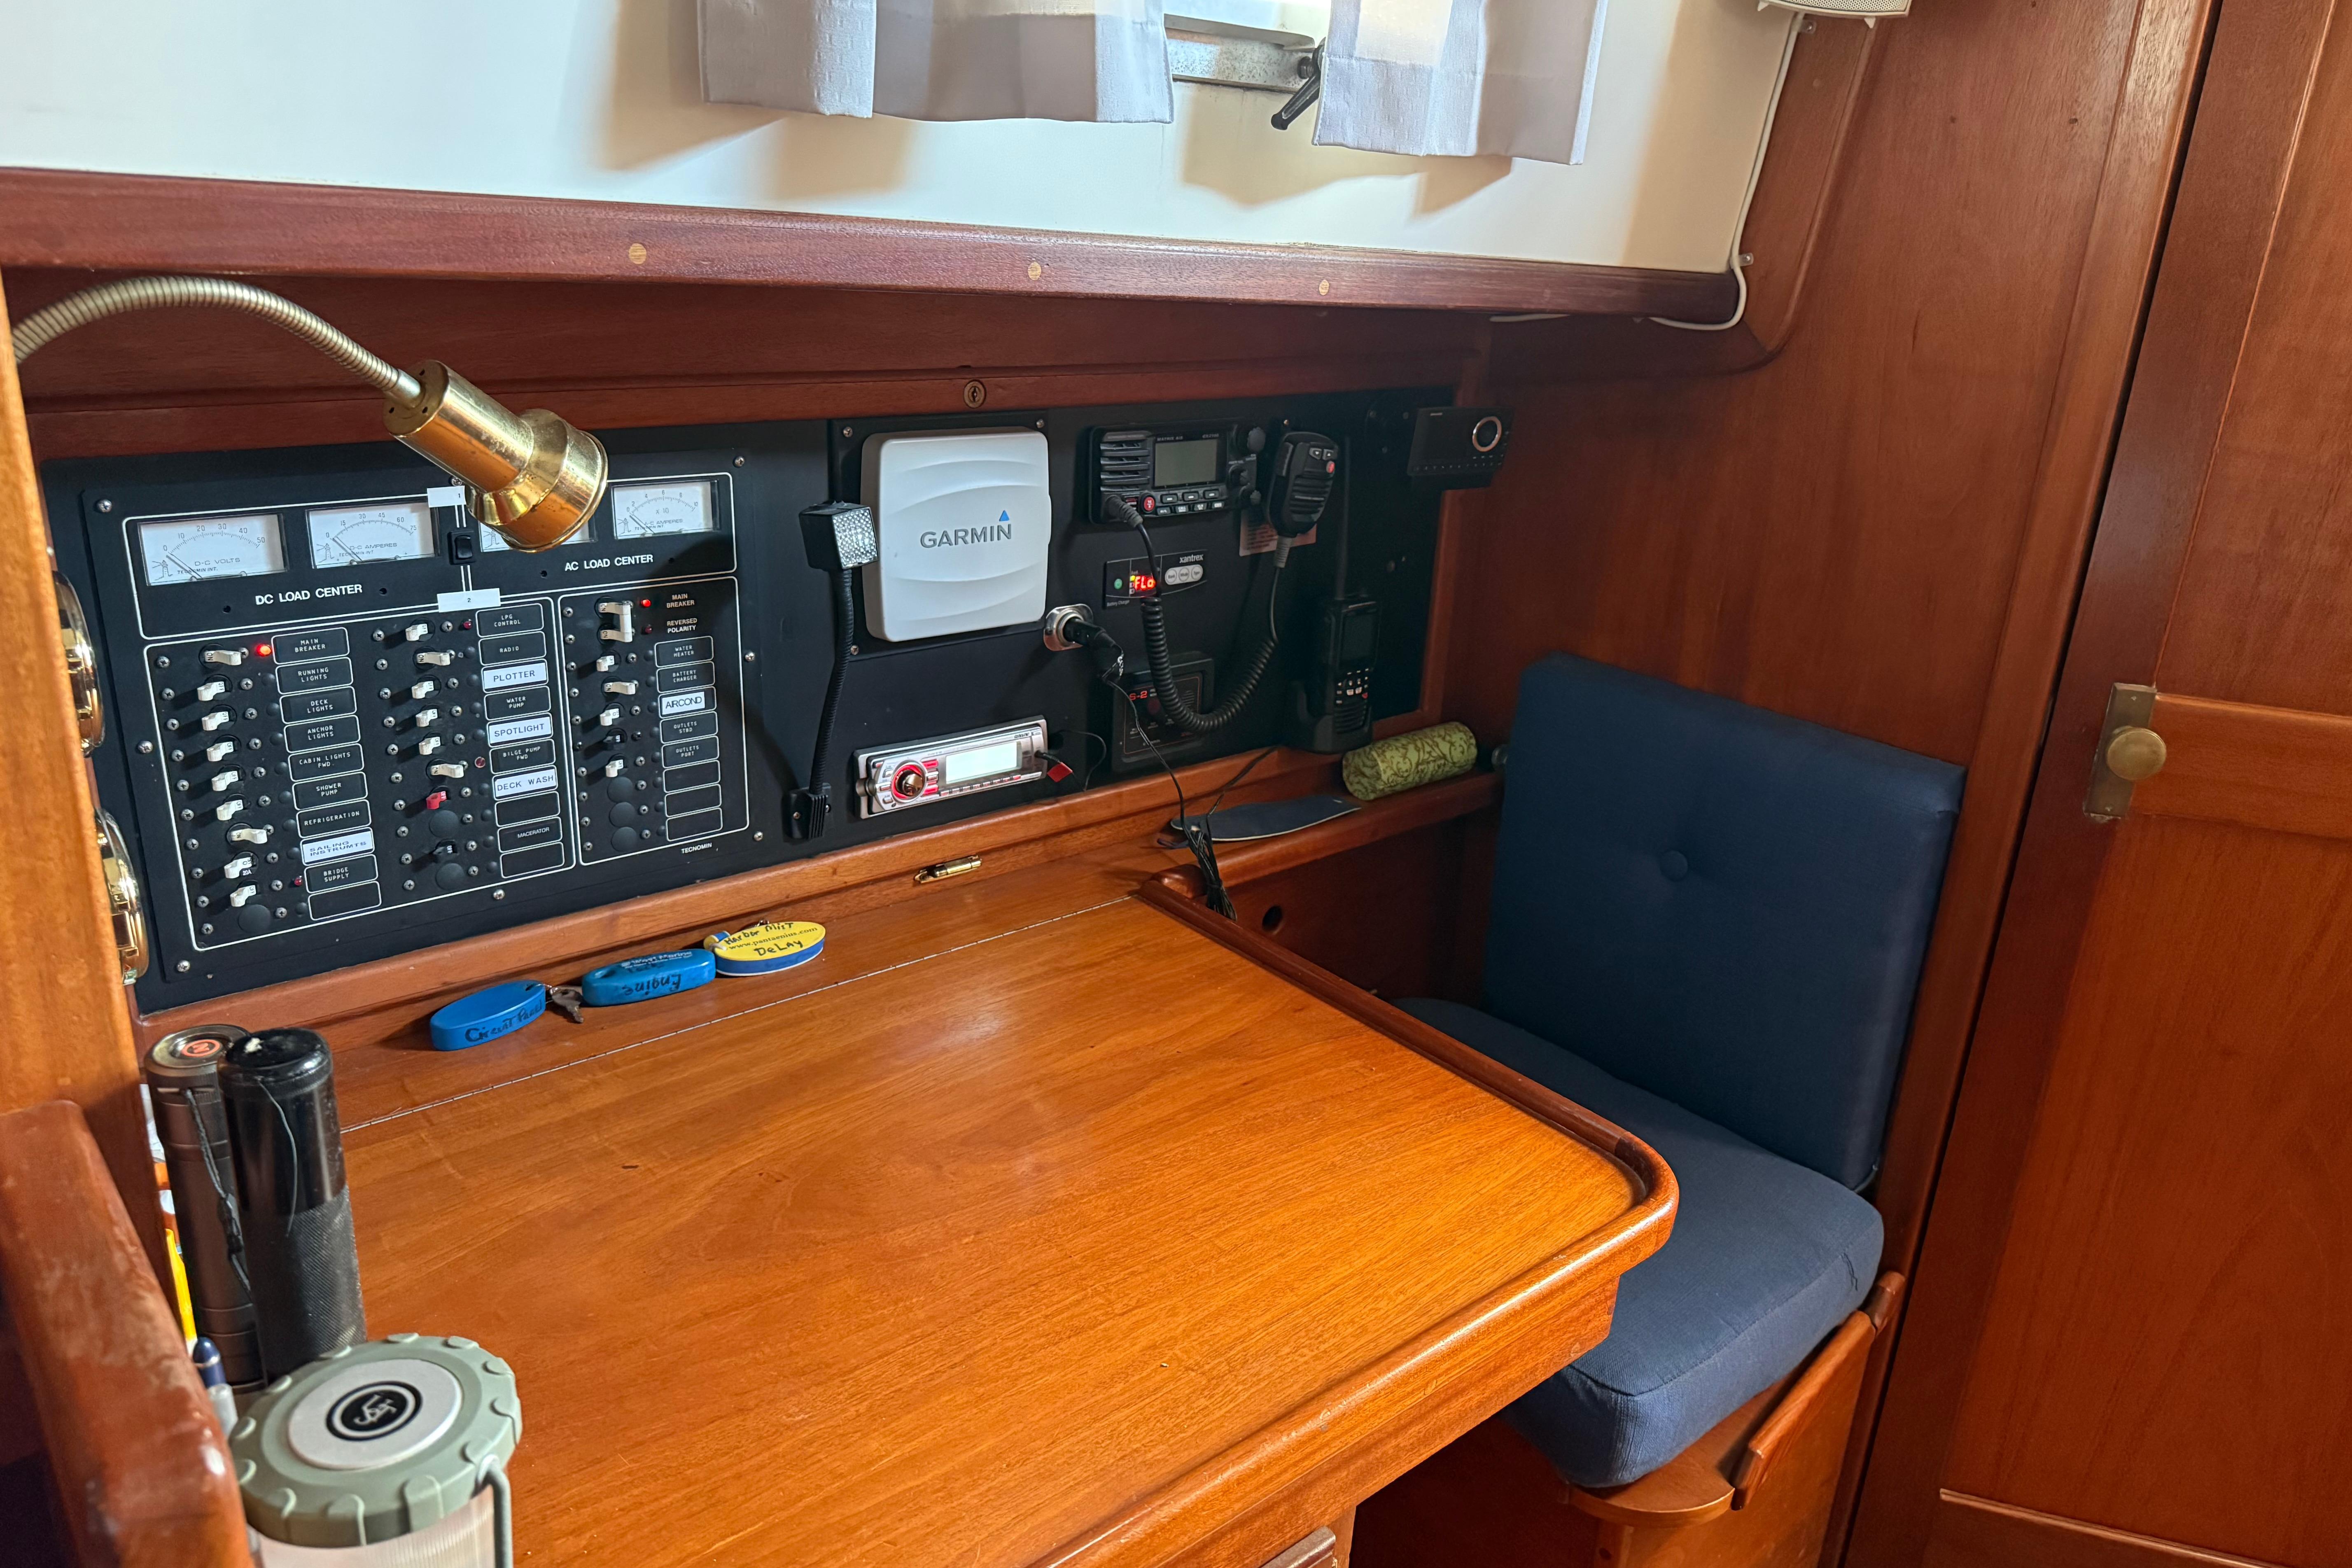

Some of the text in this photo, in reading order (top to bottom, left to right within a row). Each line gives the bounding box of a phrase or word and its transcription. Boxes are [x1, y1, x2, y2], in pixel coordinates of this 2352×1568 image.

[920, 524, 1011, 548] GARMIN
[565, 554, 654, 572] AC LOAD CENTER
[1179, 554, 1204, 564] xantrex
[255, 584, 362, 605] DC LOAD CENTER
[666, 600, 695, 609] BREAKER
[667, 618, 698, 627] REVERSED
[667, 625, 697, 634] POLARITY
[294, 644, 326, 653] BREAKER
[298, 667, 329, 677] RUNNING
[493, 670, 536, 682] PLOTTER
[301, 674, 327, 683] LIGHTS
[665, 696, 702, 709] AIRCOND
[307, 705, 334, 714] LIGHTS
[307, 725, 334, 734] ANCHOR
[494, 723, 545, 737] SPOTLIGHT
[673, 721, 697, 729] OUTLETS
[308, 732, 334, 740] LIGHTS
[503, 749, 522, 758] BILGE
[675, 745, 700, 754] OUTLETS
[299, 752, 351, 765] CABIN LIGHTS
[316, 782, 342, 792] SHOWER
[497, 775, 554, 791] DECK WASH
[304, 810, 360, 826] REFRIGERATION
[517, 827, 550, 838] MACERATOR
[310, 841, 349, 852] SAILING
[310, 841, 367, 857] INSTRUMTS
[681, 842, 712, 854] TECNOMIN
[323, 866, 349, 877] BRIDGE
[324, 873, 350, 882] SUPPLY
[729, 927, 818, 950] www.pantaenius.com
